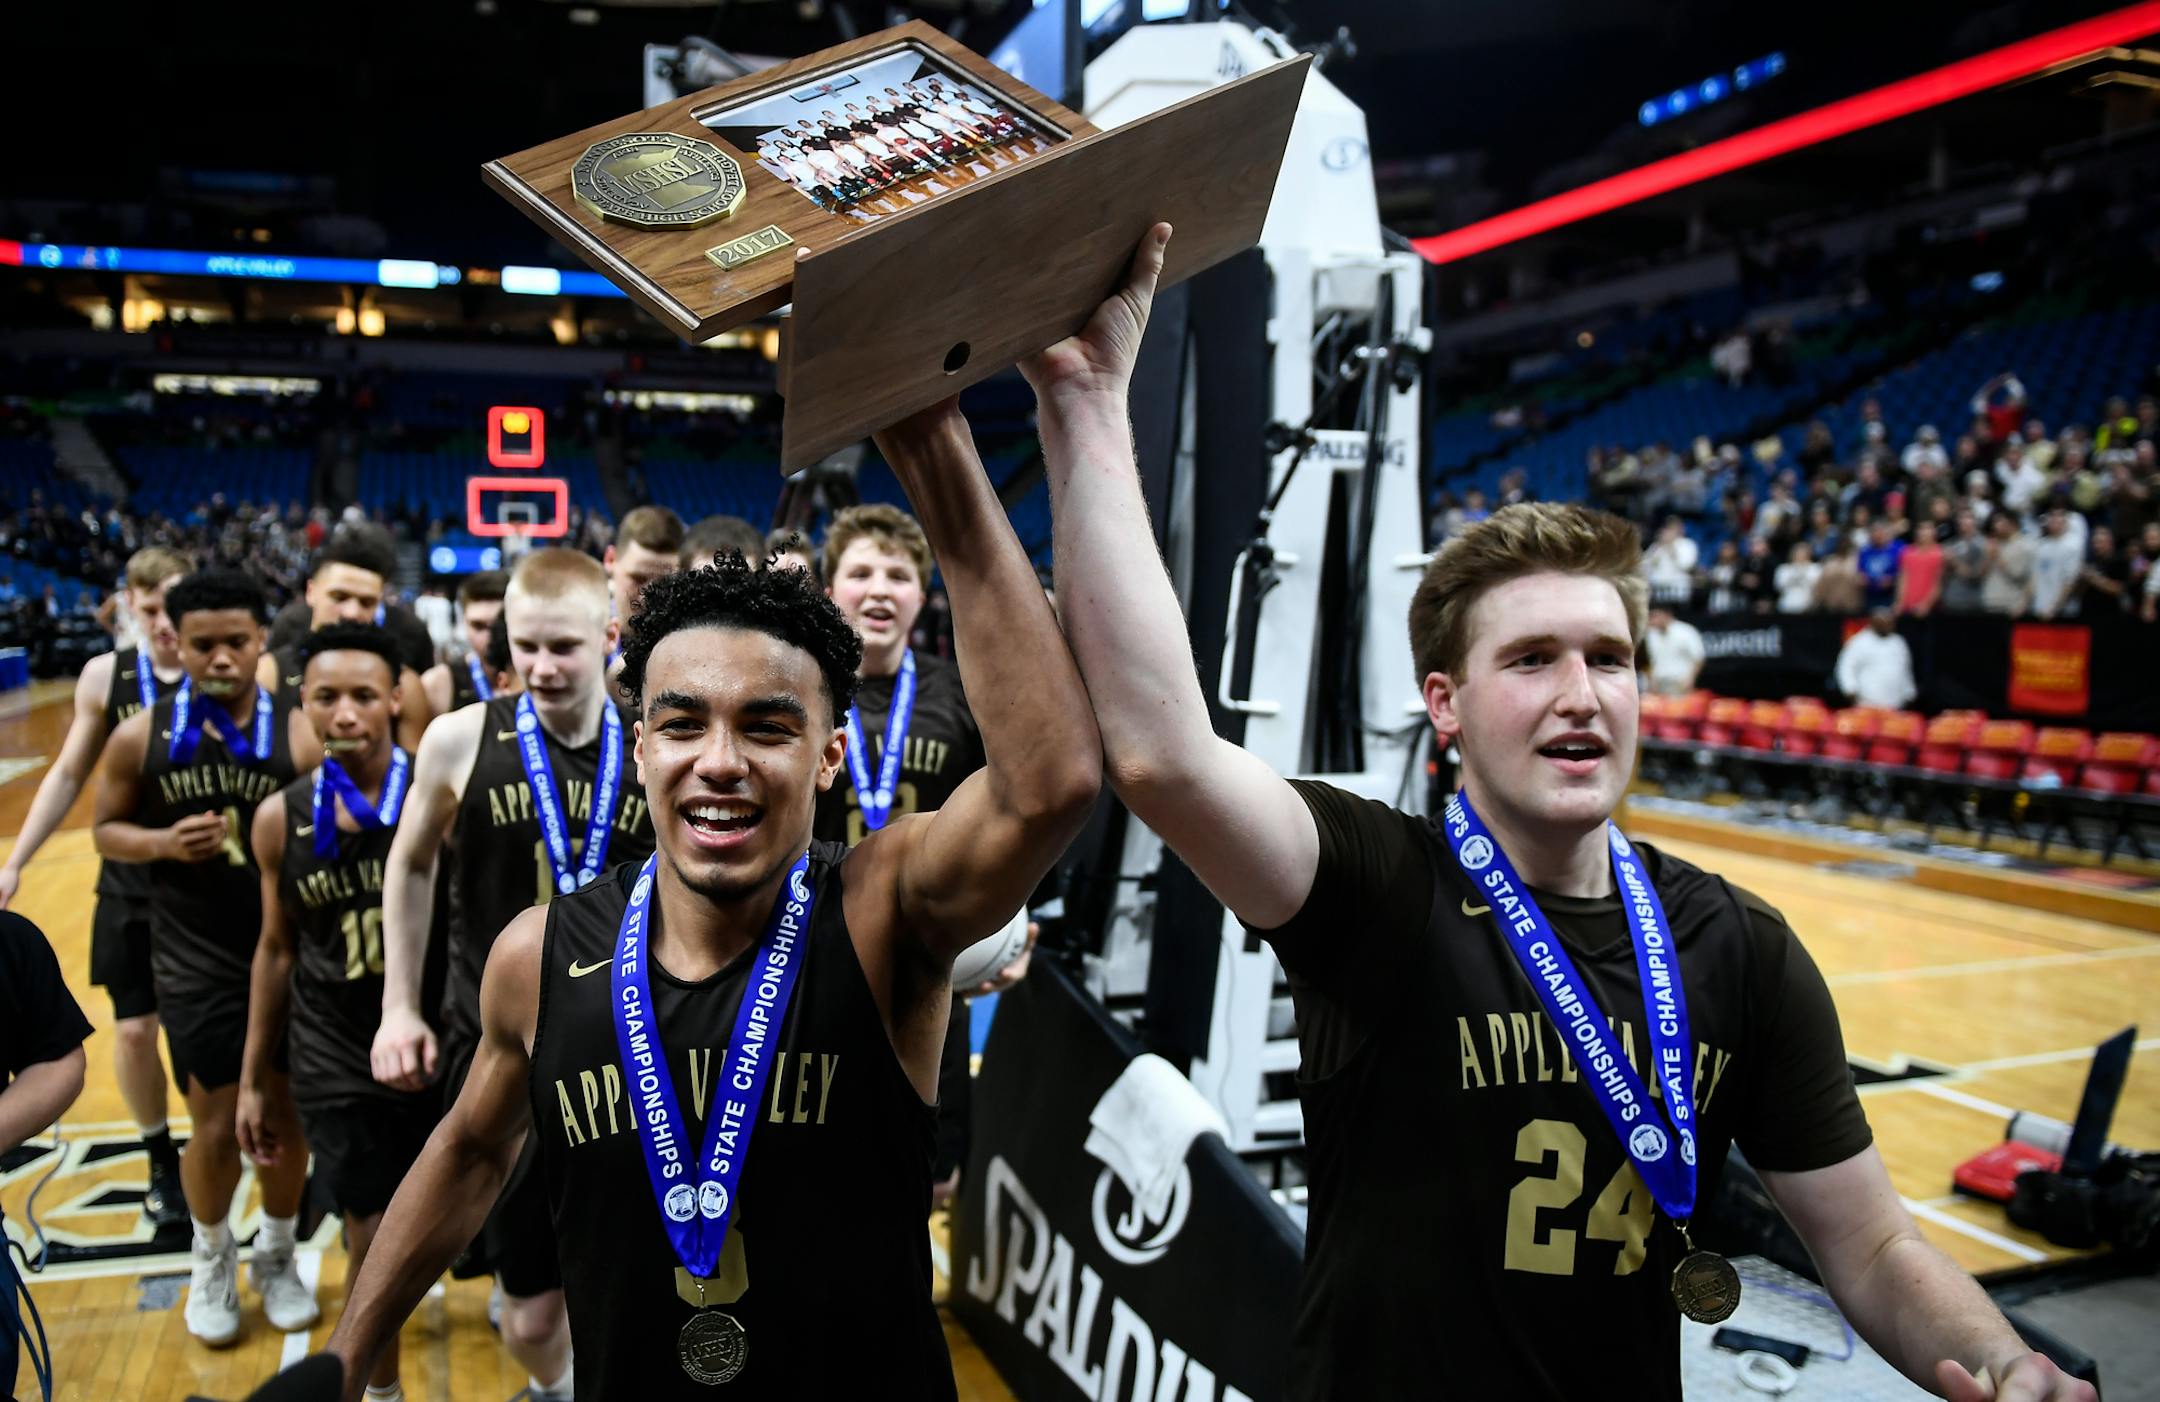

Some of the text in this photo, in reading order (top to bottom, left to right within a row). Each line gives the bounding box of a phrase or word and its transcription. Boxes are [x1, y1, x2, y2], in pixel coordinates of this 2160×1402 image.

[611, 156, 703, 199] MSHSL
[690, 188, 737, 219] SCHOOL
[706, 150, 740, 190] LEAGUE
[640, 211, 685, 222] HIGH
[718, 228, 782, 264] 2017
[523, 733, 544, 771] STATE
[1485, 869, 1537, 937] STATE
[620, 910, 642, 978] STATE
[1618, 860, 1679, 1037] CHAMPIONSHIPS
[732, 899, 805, 1091] CHAMPIONSHIPS
[1529, 941, 1641, 1122] CHAMPIONSHIPS
[621, 985, 683, 1179] CHAMPIONSHIPS
[688, 1048, 839, 1125] VLEY
[1662, 1047, 1690, 1121] STATE
[710, 1100, 747, 1175] STATE
[1504, 1118, 1656, 1276] 24
